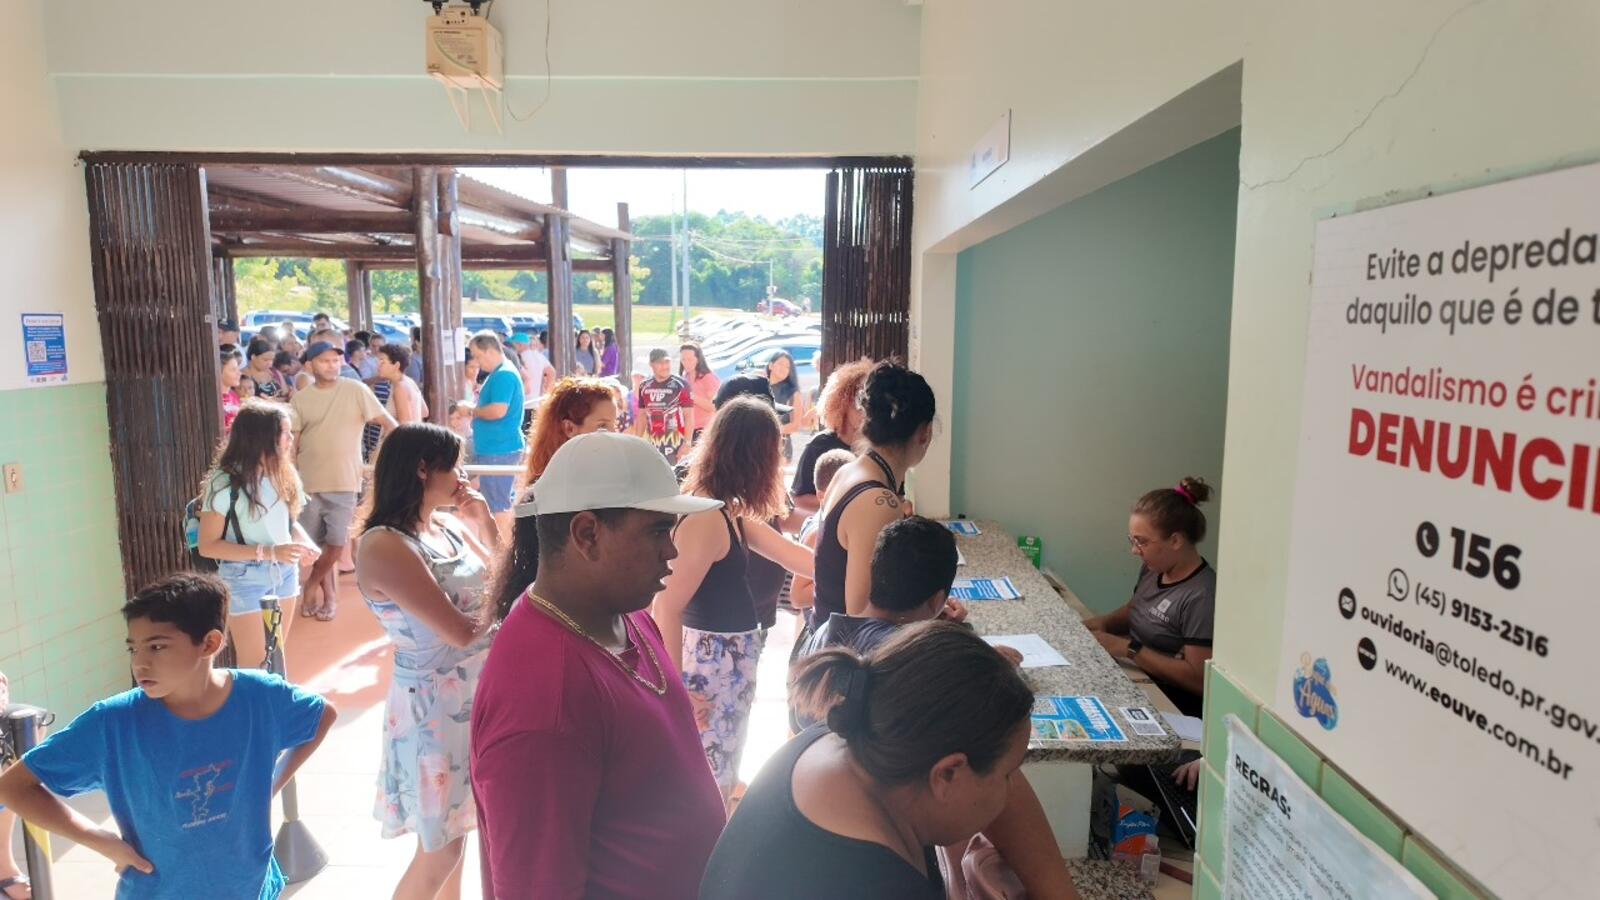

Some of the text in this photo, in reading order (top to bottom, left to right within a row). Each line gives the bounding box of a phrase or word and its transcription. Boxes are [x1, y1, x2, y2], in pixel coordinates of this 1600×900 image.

[1366, 228, 1598, 283] Evite a depreda
[1346, 294, 1433, 333] daquilo
[1439, 297, 1495, 335] que
[1503, 287, 1523, 325] é
[1532, 288, 1580, 325] de
[1351, 364, 1600, 419] Vandalismo é cri
[1450, 526, 1522, 590] 156
[1414, 582, 1549, 658] (45) 9153-2516
[1385, 657, 1574, 780] www.eouve.com.br
[1235, 754, 1291, 820] REGRAS:
